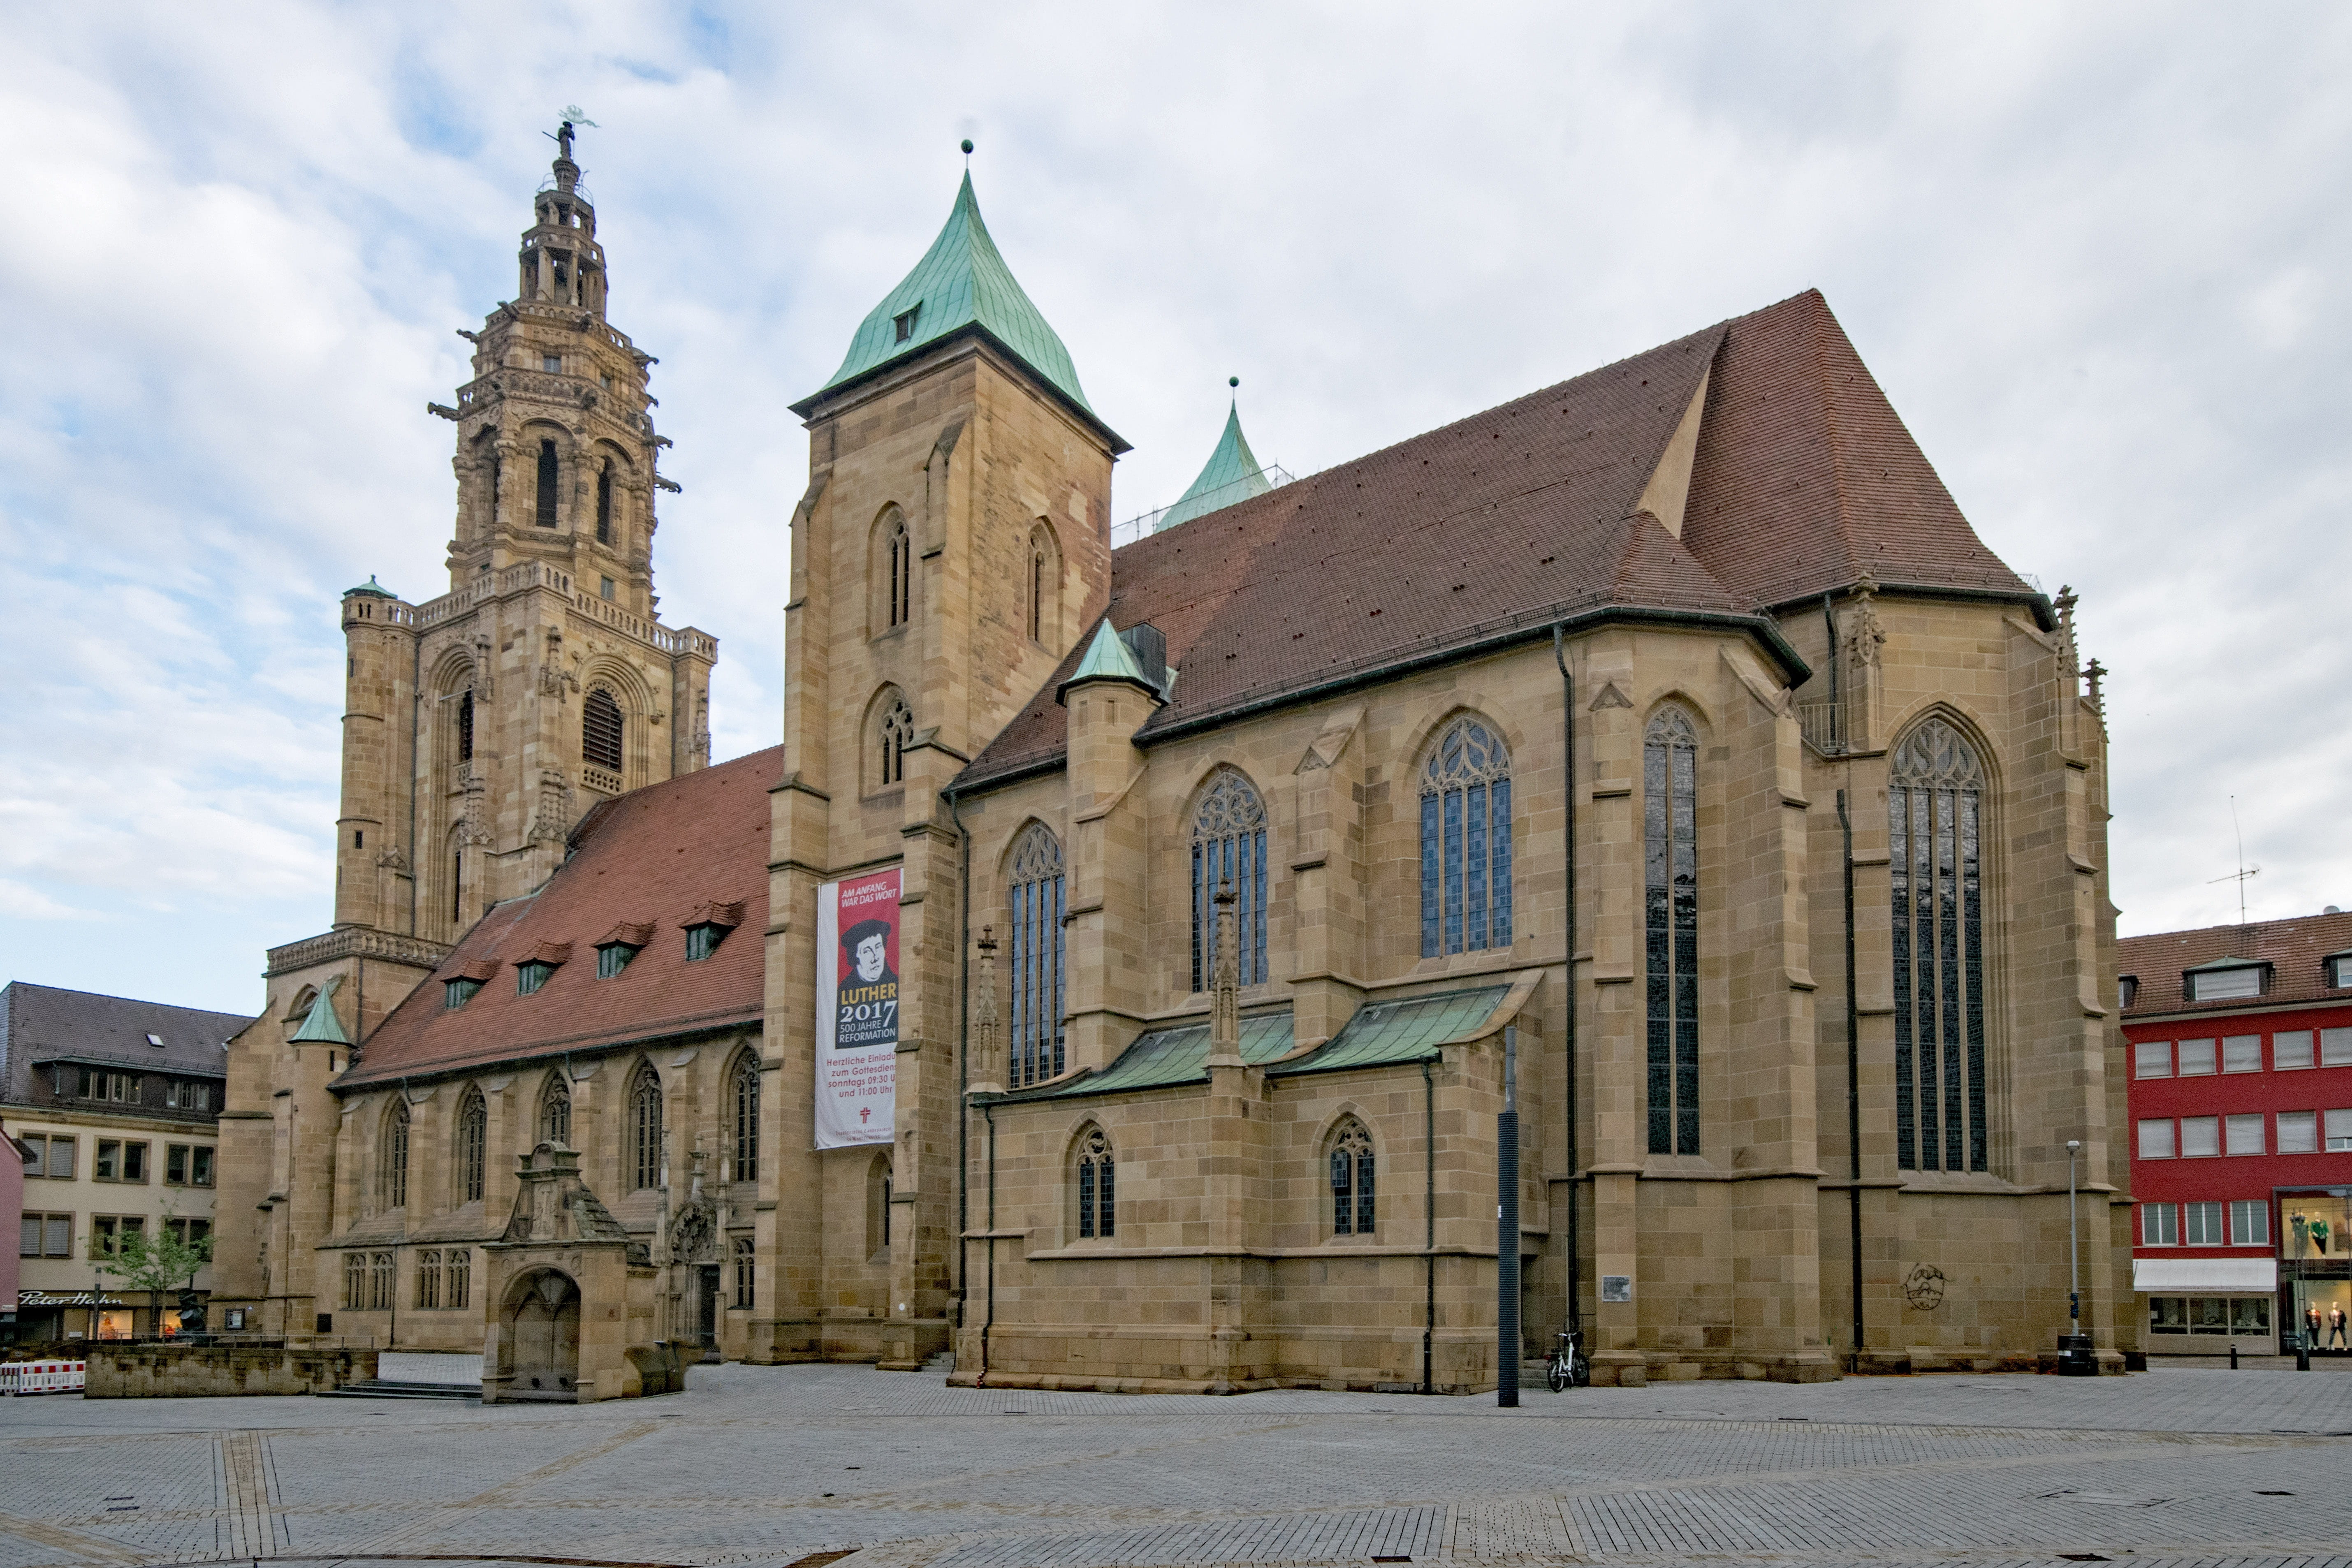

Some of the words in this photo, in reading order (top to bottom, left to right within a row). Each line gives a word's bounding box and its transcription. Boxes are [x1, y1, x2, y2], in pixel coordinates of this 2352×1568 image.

[841, 888, 855, 899] AM
[855, 882, 887, 896] ANFANG
[842, 896, 859, 908] WAR
[860, 893, 874, 904] DAS
[875, 888, 897, 901] WORT
[841, 982, 897, 1005] LUTHER
[840, 1000, 897, 1027] 2017
[840, 1024, 855, 1033] 500
[857, 1020, 881, 1031] JAHRE
[839, 1028, 896, 1043] REFORMATION
[827, 1056, 865, 1066] Herzliche
[828, 1079, 865, 1088] sonntags
[868, 1075, 888, 1084] 09:30
[839, 1089, 855, 1098] und
[858, 1087, 877, 1096] 11:00
[880, 1086, 892, 1094] Uhr
[18, 1291, 70, 1305] Peter
[69, 1292, 125, 1305] Hahn
